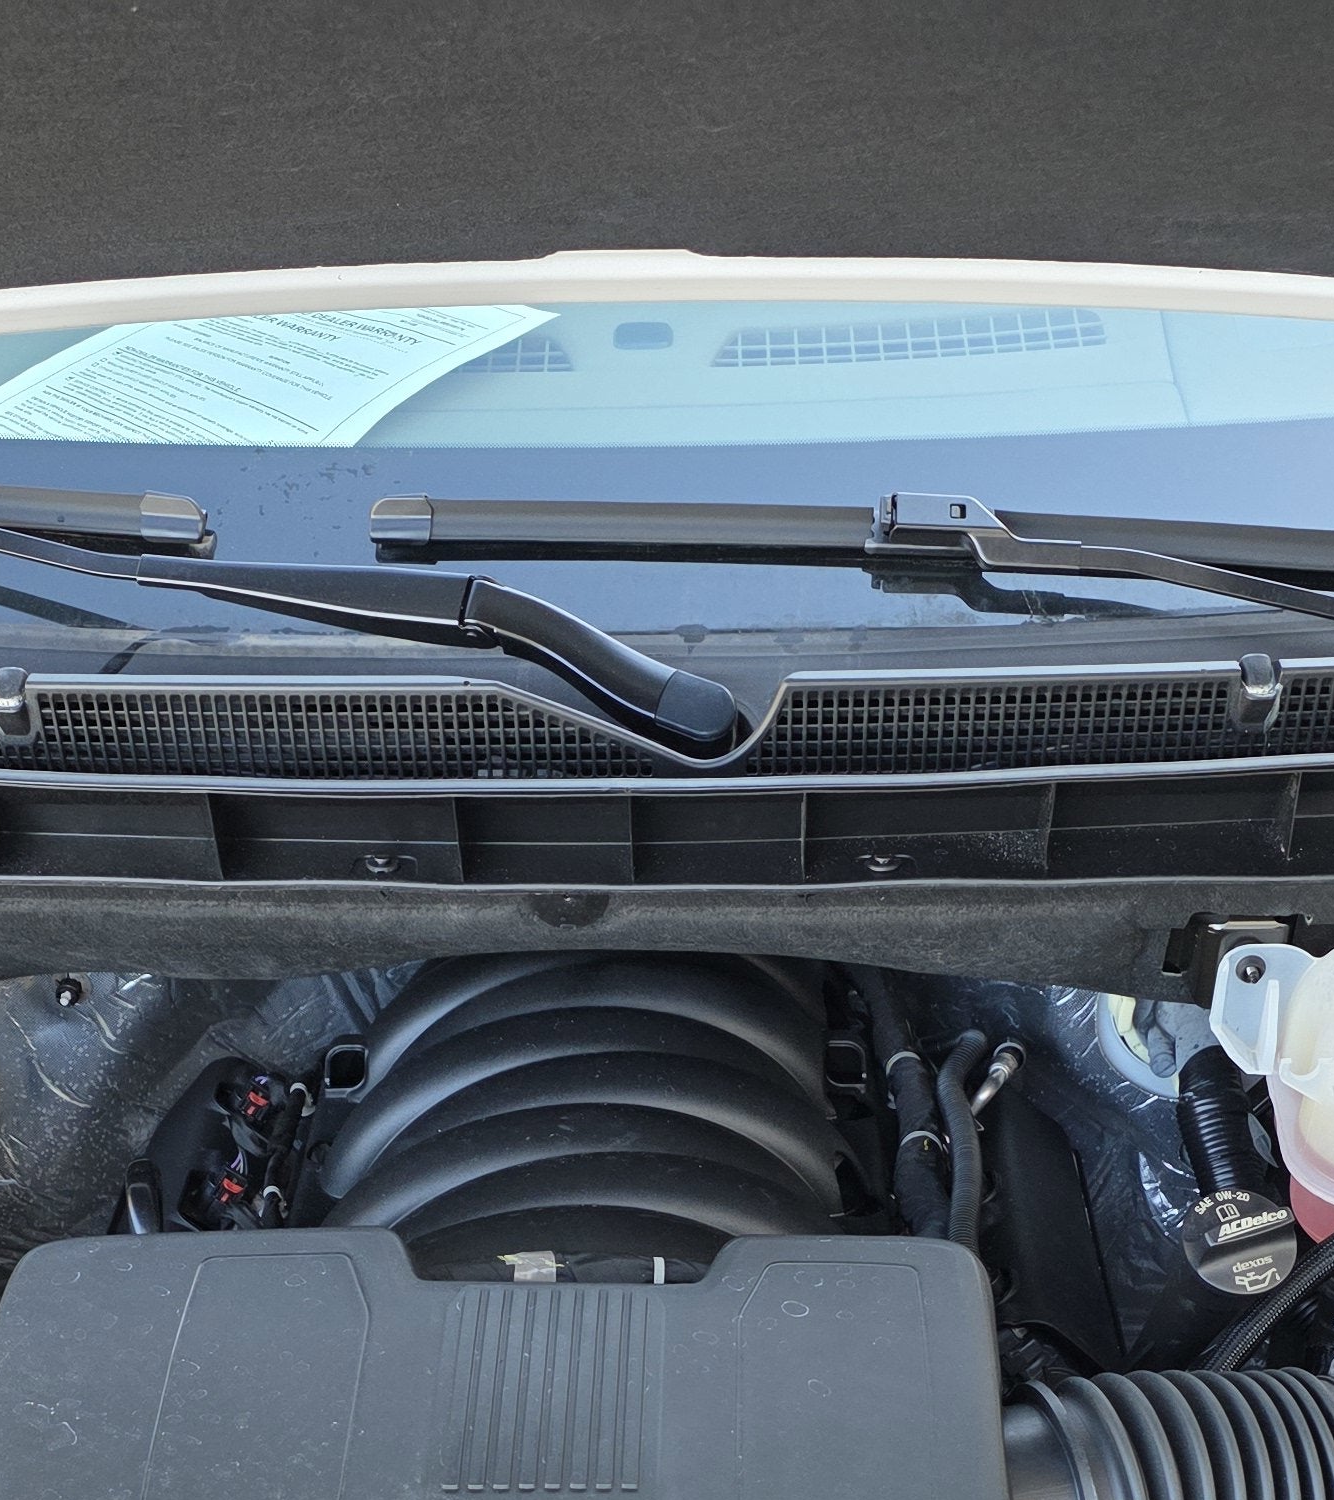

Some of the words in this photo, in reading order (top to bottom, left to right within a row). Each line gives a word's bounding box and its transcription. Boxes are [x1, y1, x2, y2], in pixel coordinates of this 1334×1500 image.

[276, 319, 341, 342] WARRANTY
[310, 312, 357, 329] DEALER
[357, 322, 422, 346] WARRANTY
[1194, 1196, 1215, 1215] SAE
[1215, 1190, 1250, 1202] 0W-20
[1218, 1208, 1288, 1238] ACDelco
[1232, 1255, 1274, 1273] dexos
